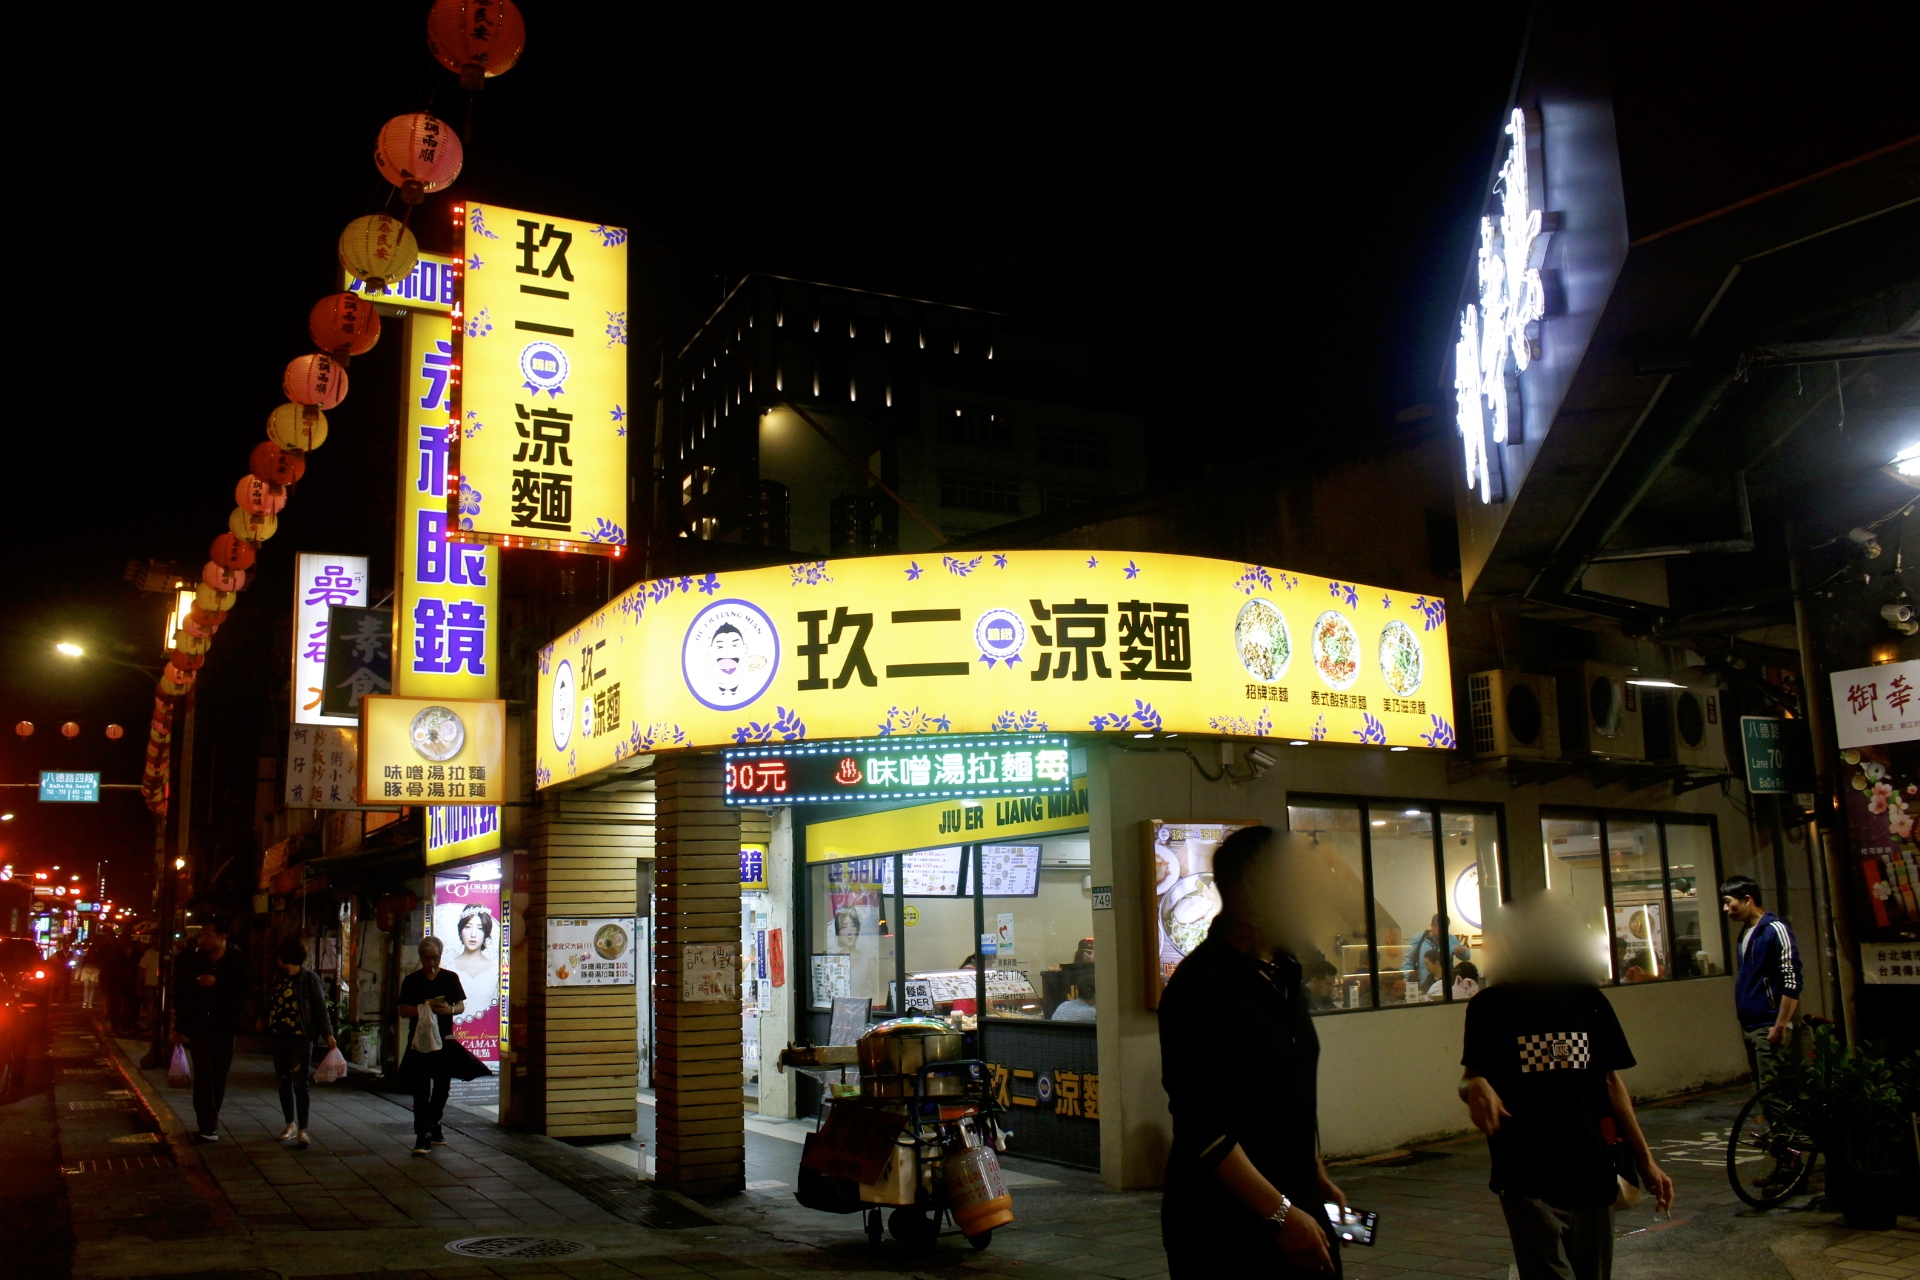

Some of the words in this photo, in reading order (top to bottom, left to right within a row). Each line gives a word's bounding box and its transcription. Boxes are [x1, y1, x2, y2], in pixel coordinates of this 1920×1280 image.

[516, 219, 574, 337] 玖二
[511, 402, 573, 533] 涼麵
[744, 615, 763, 635] MIAN
[797, 606, 969, 691] 玖二
[1029, 597, 1193, 682] 涼麵
[337, 615, 392, 709] 素食
[581, 638, 607, 691] 玖二
[1245, 684, 1289, 703] 招牌涼麵
[1310, 690, 1368, 710] 泰式酸辣涼麵
[1847, 674, 1920, 722] 御華
[593, 681, 621, 739] 涼麵
[1382, 697, 1427, 715] 美乃滋涼麵
[291, 728, 308, 802] 蚵仔煎
[384, 765, 486, 781] 味噌湯拉麵
[1751, 758, 1768, 769] Lane
[46, 773, 94, 783] 八德路四段
[1759, 777, 1775, 788] BaDe
[384, 782, 486, 798] 豚骨湯拉麵
[938, 809, 961, 834] JIU
[965, 806, 984, 831] ER
[997, 795, 1043, 826] LIANG
[1047, 788, 1089, 819] MIAN
[1094, 894, 1110, 907] 749
[905, 998, 929, 1007] RDER
